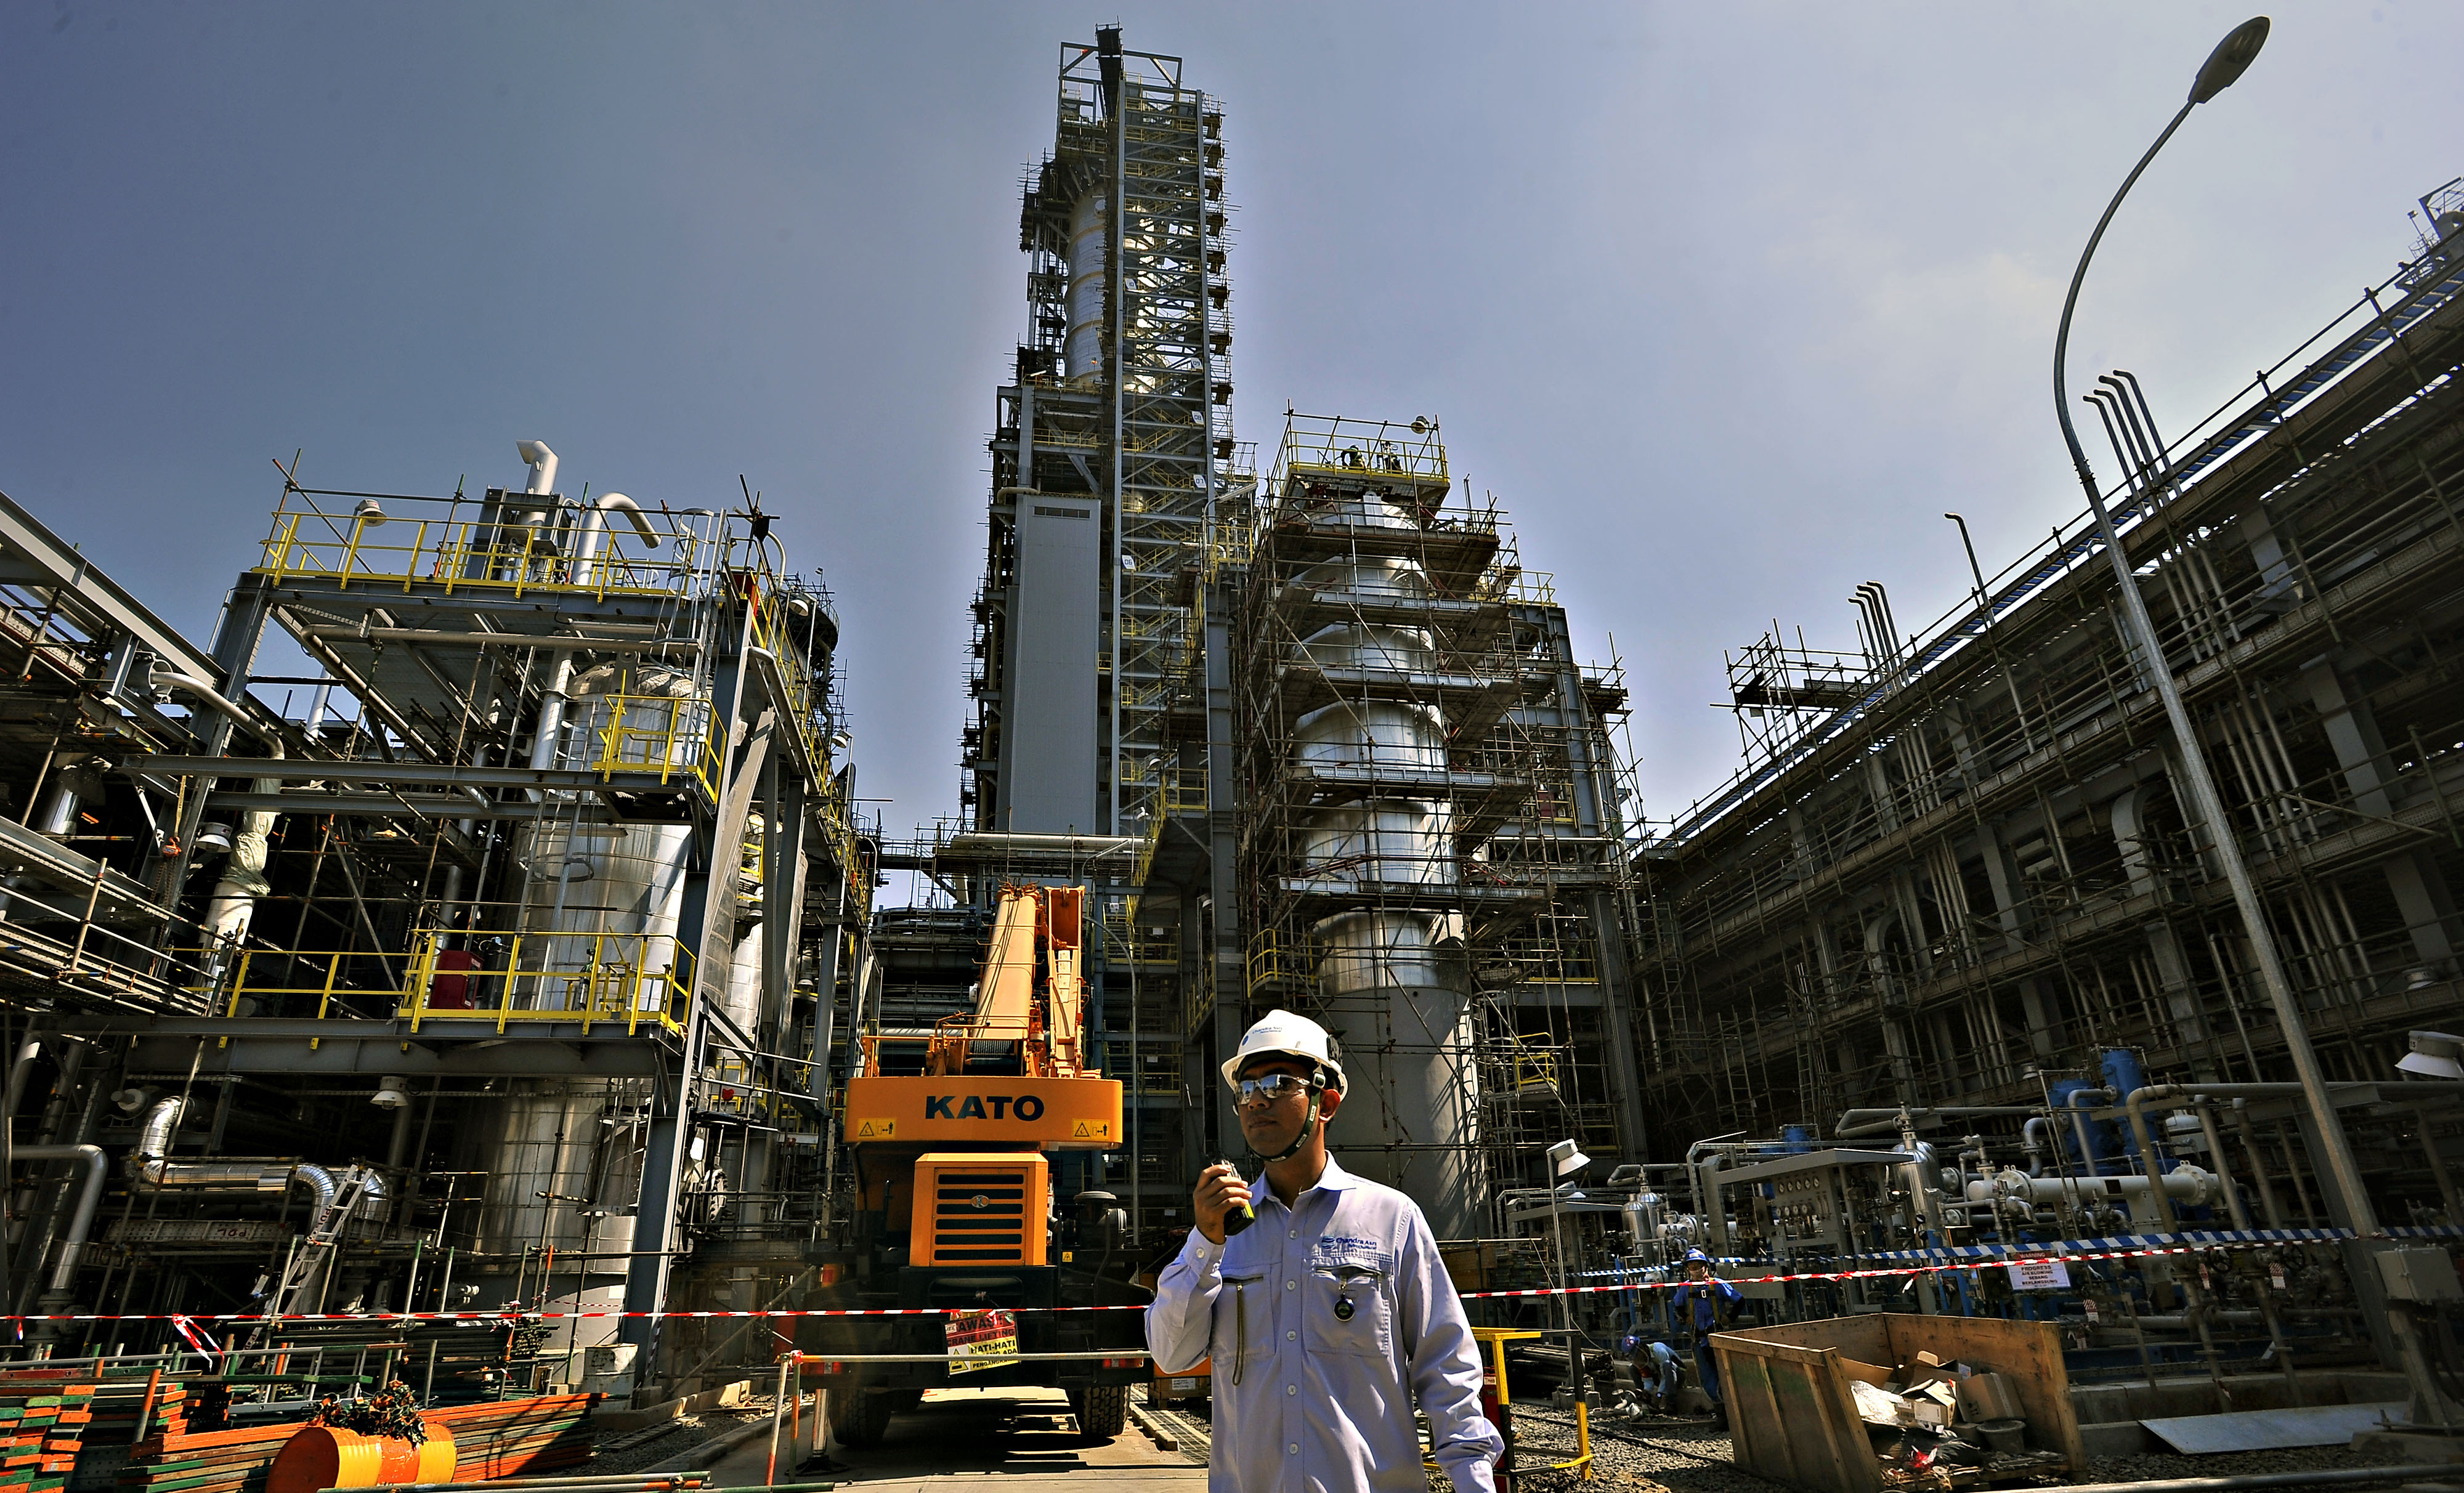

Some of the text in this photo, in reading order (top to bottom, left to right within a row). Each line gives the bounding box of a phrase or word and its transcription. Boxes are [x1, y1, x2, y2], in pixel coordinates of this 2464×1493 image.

[925, 1095, 1045, 1121] KATO
[948, 1329, 1015, 1346] CRANE LIFTING
[971, 1340, 1015, 1354] HATI-HATI
